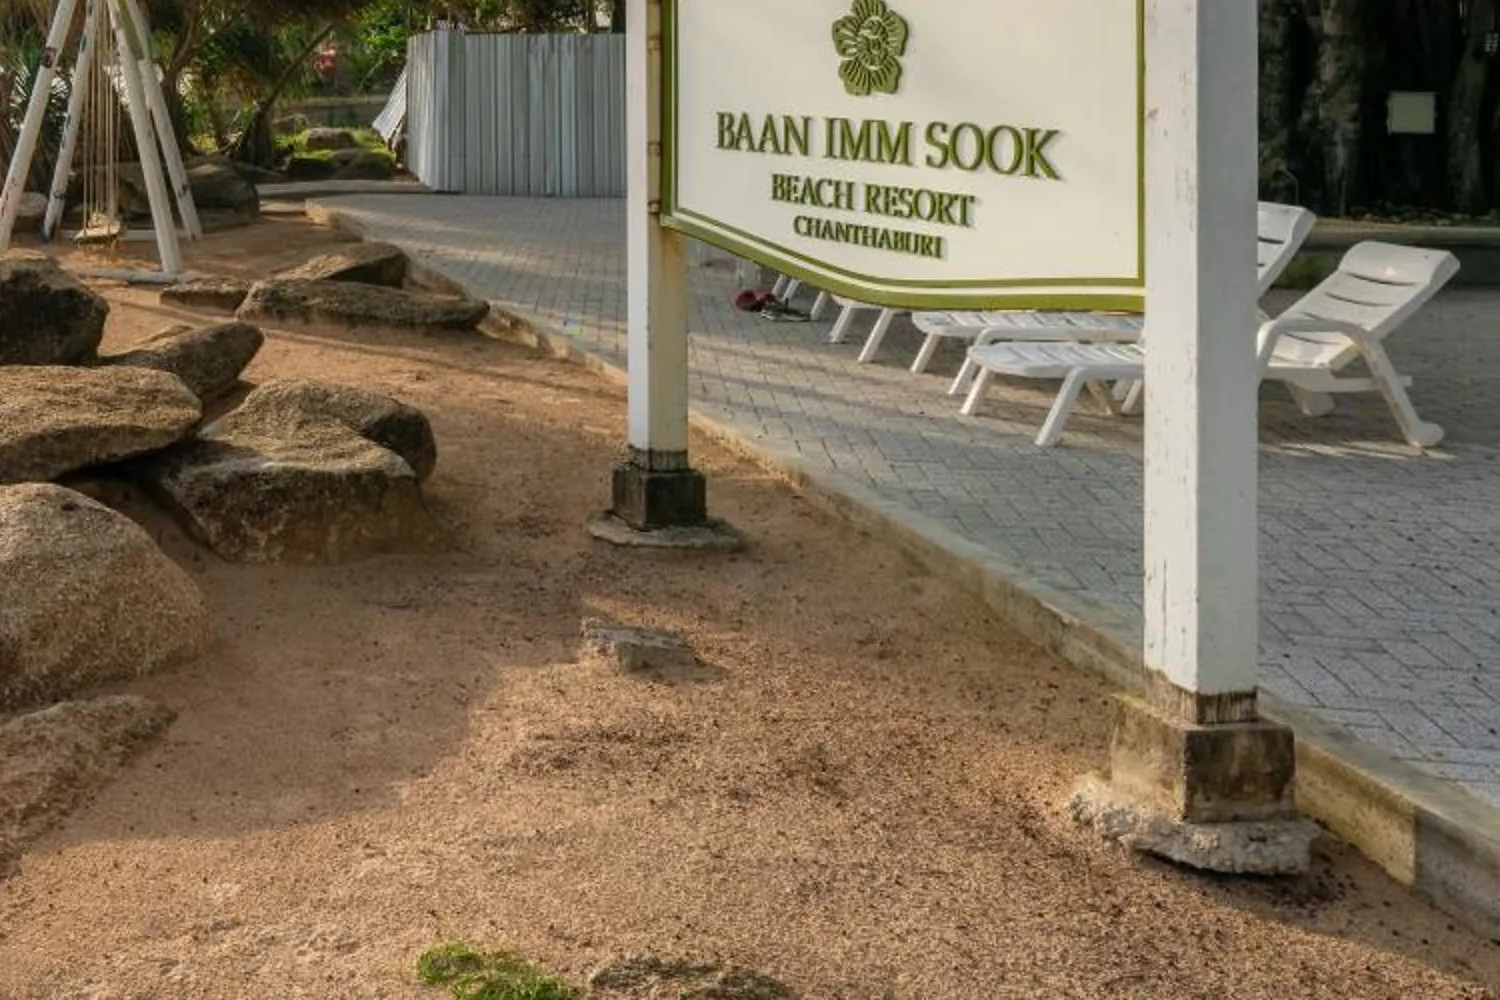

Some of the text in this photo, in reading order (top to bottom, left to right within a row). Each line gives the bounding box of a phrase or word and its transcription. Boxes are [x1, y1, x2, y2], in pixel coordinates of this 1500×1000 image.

[716, 111, 1061, 180] BAAN IMM SOOK
[771, 173, 977, 228] BEACH RESORT
[793, 215, 944, 259] CHANTHABURI
